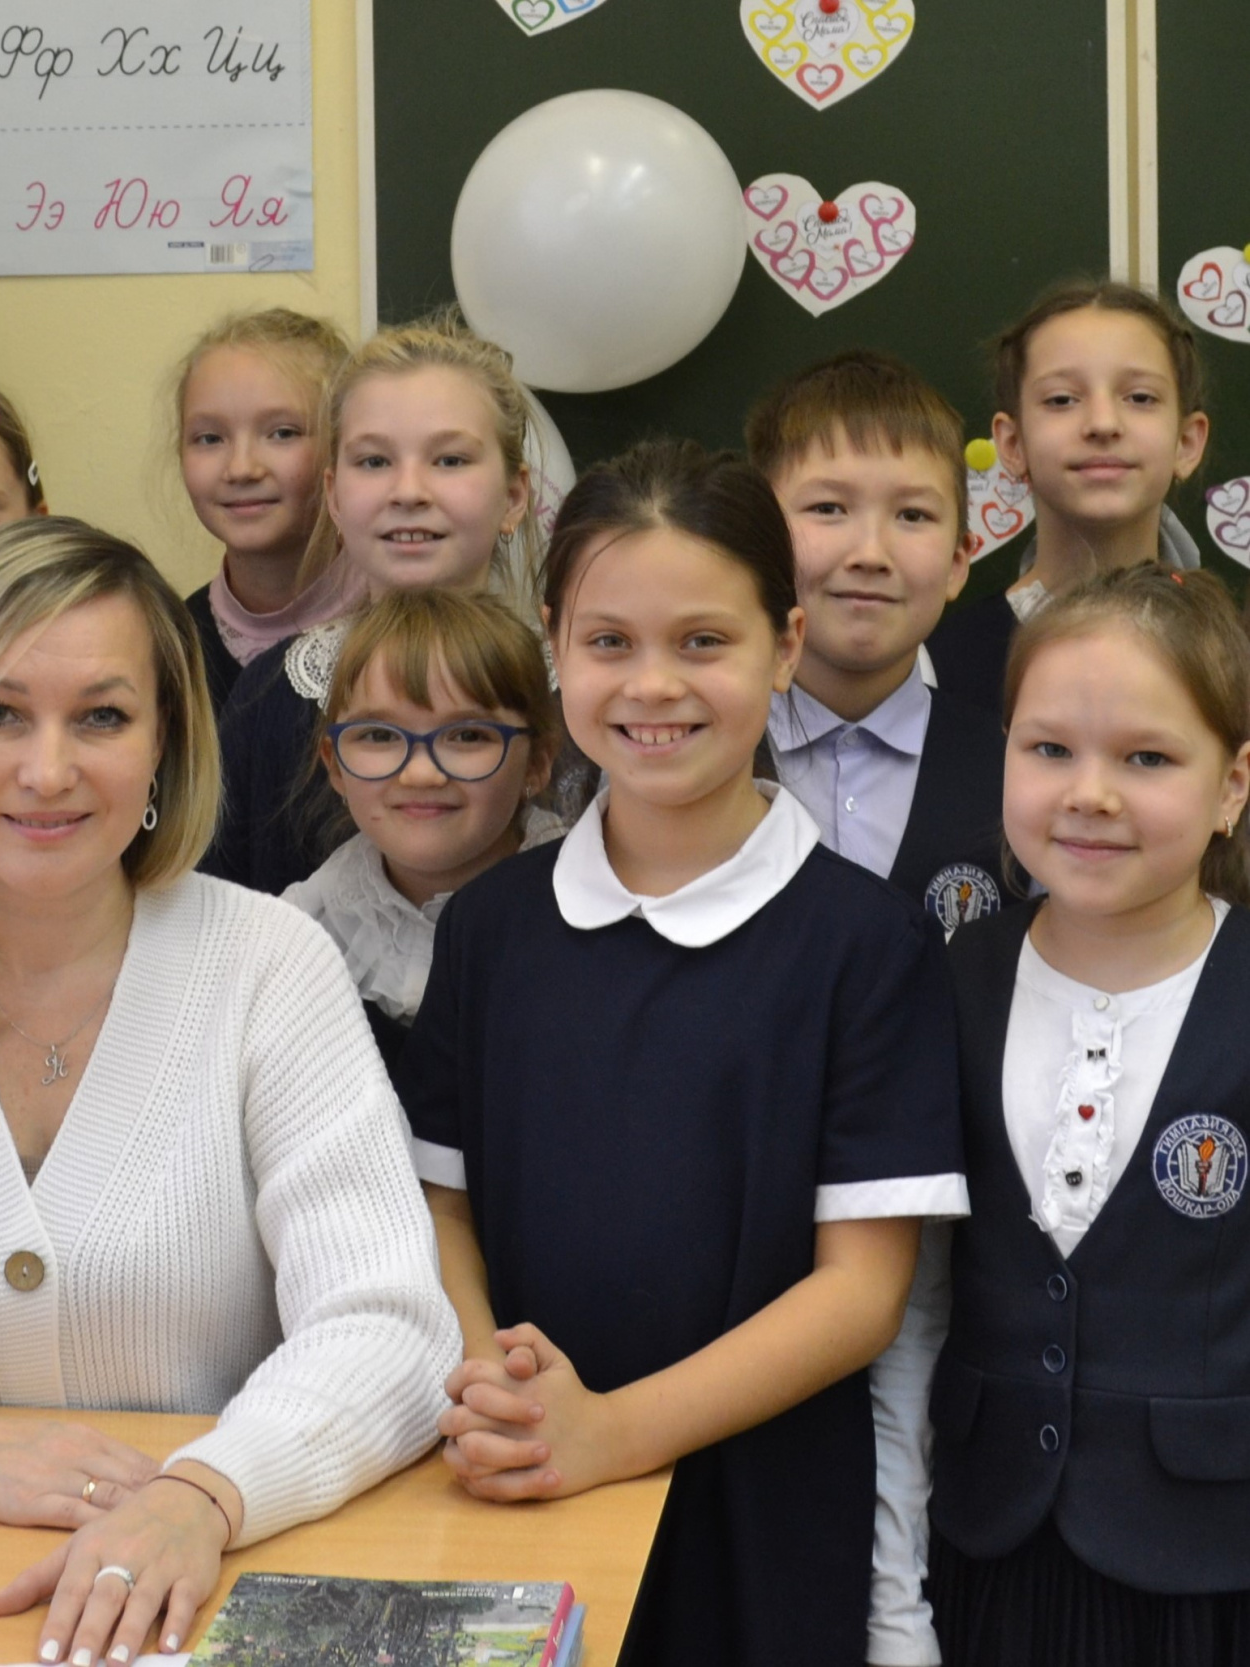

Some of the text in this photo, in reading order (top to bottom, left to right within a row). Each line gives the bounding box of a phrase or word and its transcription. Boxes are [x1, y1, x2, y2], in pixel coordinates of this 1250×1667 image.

[802, 20, 851, 42] Мама!
[96, 26, 182, 77] Хх
[203, 25, 286, 83] Цц
[16, 181, 65, 232] Ээ
[93, 177, 181, 230] Юю
[209, 174, 289, 228] Яя
[806, 221, 853, 245] Мама!
[928, 865, 985, 896] ГИМНАЗИЯ
[1158, 1115, 1231, 1155] ГИМНАЗИЯ
[1159, 1178, 1241, 1217] ЙОШКАР-ОЛА
